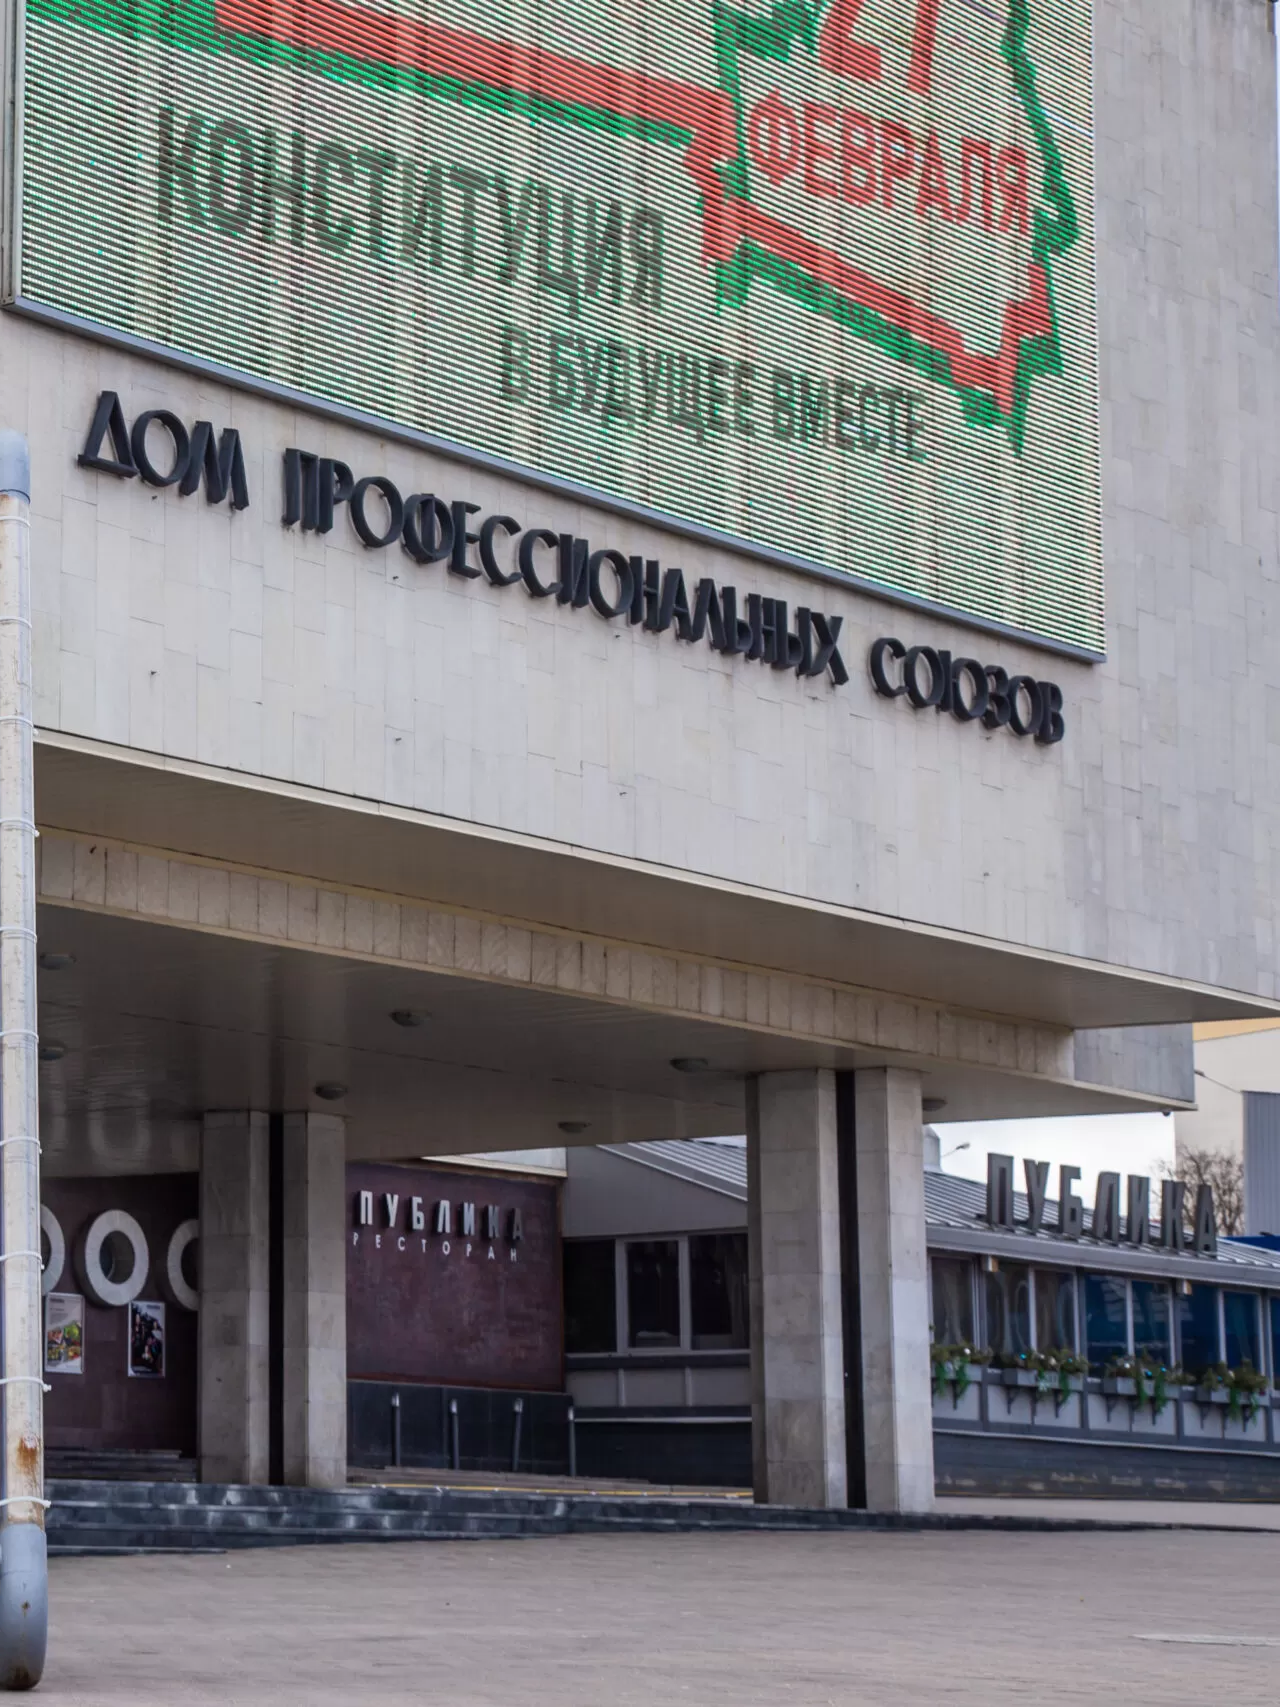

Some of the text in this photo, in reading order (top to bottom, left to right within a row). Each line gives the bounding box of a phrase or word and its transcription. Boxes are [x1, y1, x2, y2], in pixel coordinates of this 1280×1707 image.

[156, 104, 664, 318] КОНСТИТУЦИЯ
[746, 90, 1028, 236] ФЕВРАЛЯ
[500, 324, 927, 462] В БУДУЩЕЕ ВМЕСТЕ
[77, 390, 1065, 744] ДОМ ПРОФЕССИОНАЛЬНЫХ СОЮЗОВ
[352, 1231, 518, 1263] РЕСТОРАН
[356, 1190, 524, 1241] ПУБЛИКА
[985, 1152, 1219, 1258] ПУБЛИКА
